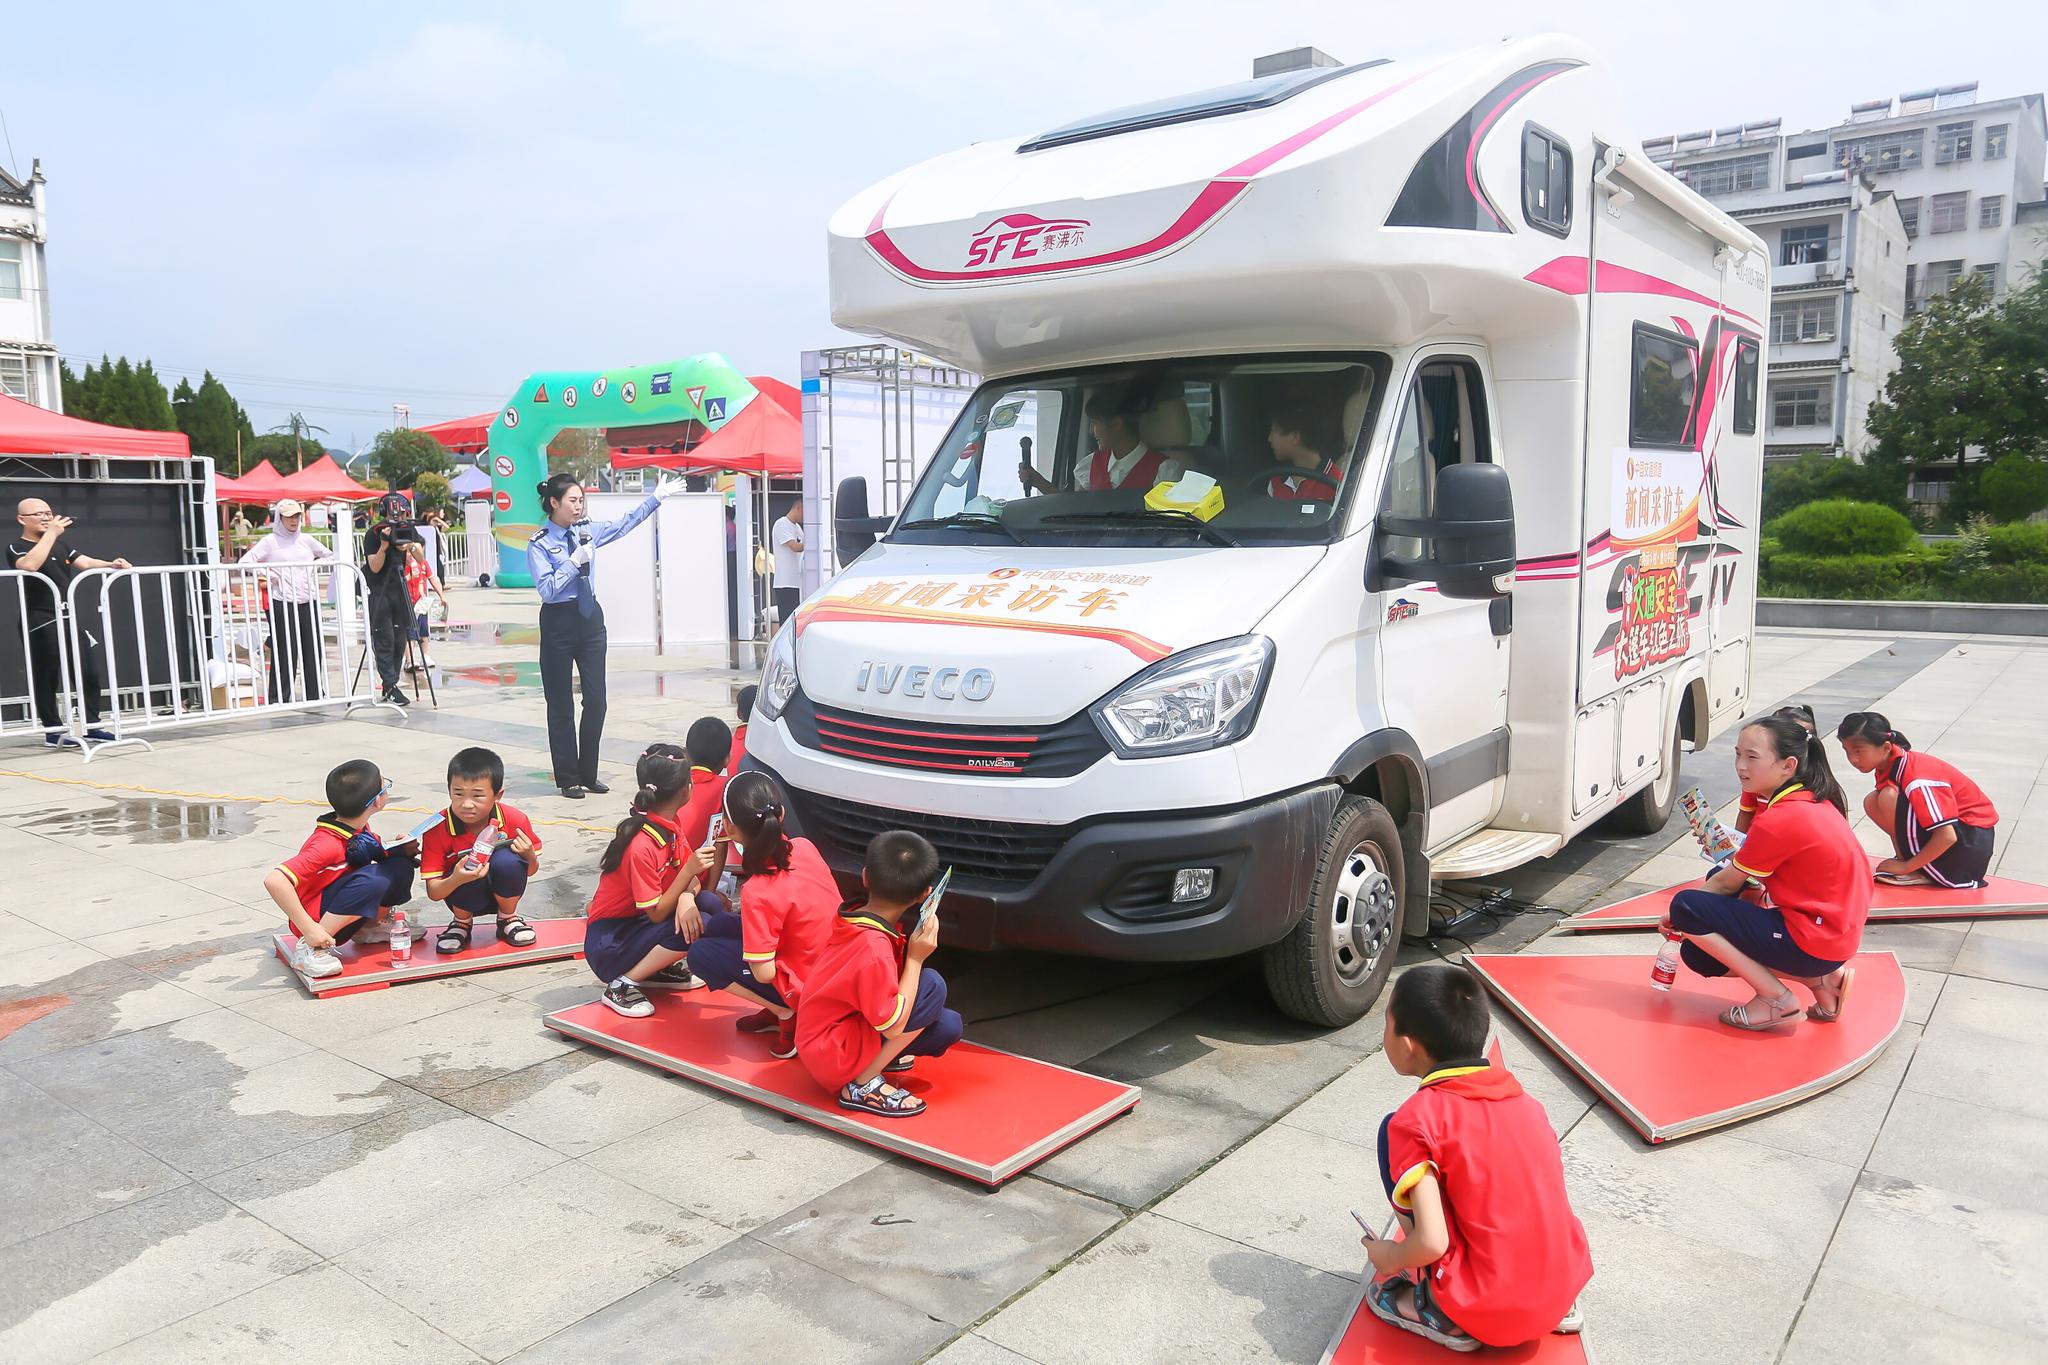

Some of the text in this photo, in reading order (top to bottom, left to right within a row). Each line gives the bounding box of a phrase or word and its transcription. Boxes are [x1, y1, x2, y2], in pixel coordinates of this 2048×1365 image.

[964, 227, 1085, 268] SFE 赛沸尔
[1625, 484, 1684, 529] 新闻采访车
[847, 580, 1129, 617] 新闻采访车
[1022, 570, 1152, 587] 中国交通频道
[1633, 569, 1677, 624] 交通安全
[1616, 613, 1686, 671] 大篷车红色之旅
[856, 660, 995, 702] IVECO
[968, 759, 995, 767] DAILY
